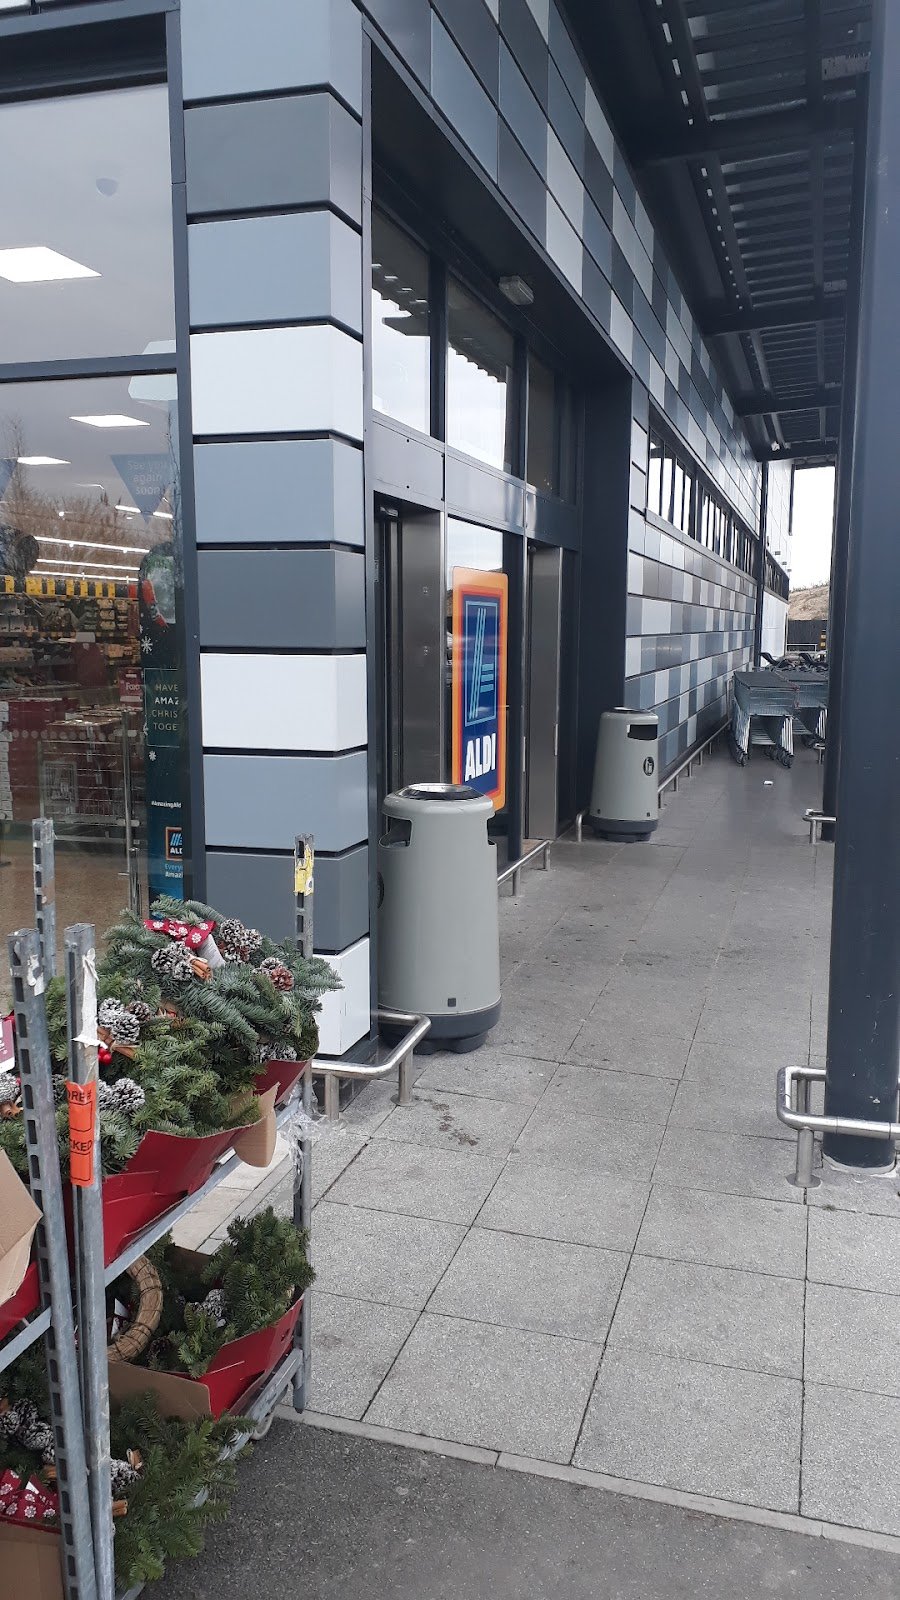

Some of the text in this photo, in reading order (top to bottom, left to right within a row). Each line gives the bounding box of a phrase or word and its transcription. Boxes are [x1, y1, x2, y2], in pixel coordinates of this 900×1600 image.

[155, 683, 179, 692] HAVE
[152, 709, 178, 719] CHRIS
[153, 722, 178, 731] TOGE
[465, 733, 496, 783] ALDI
